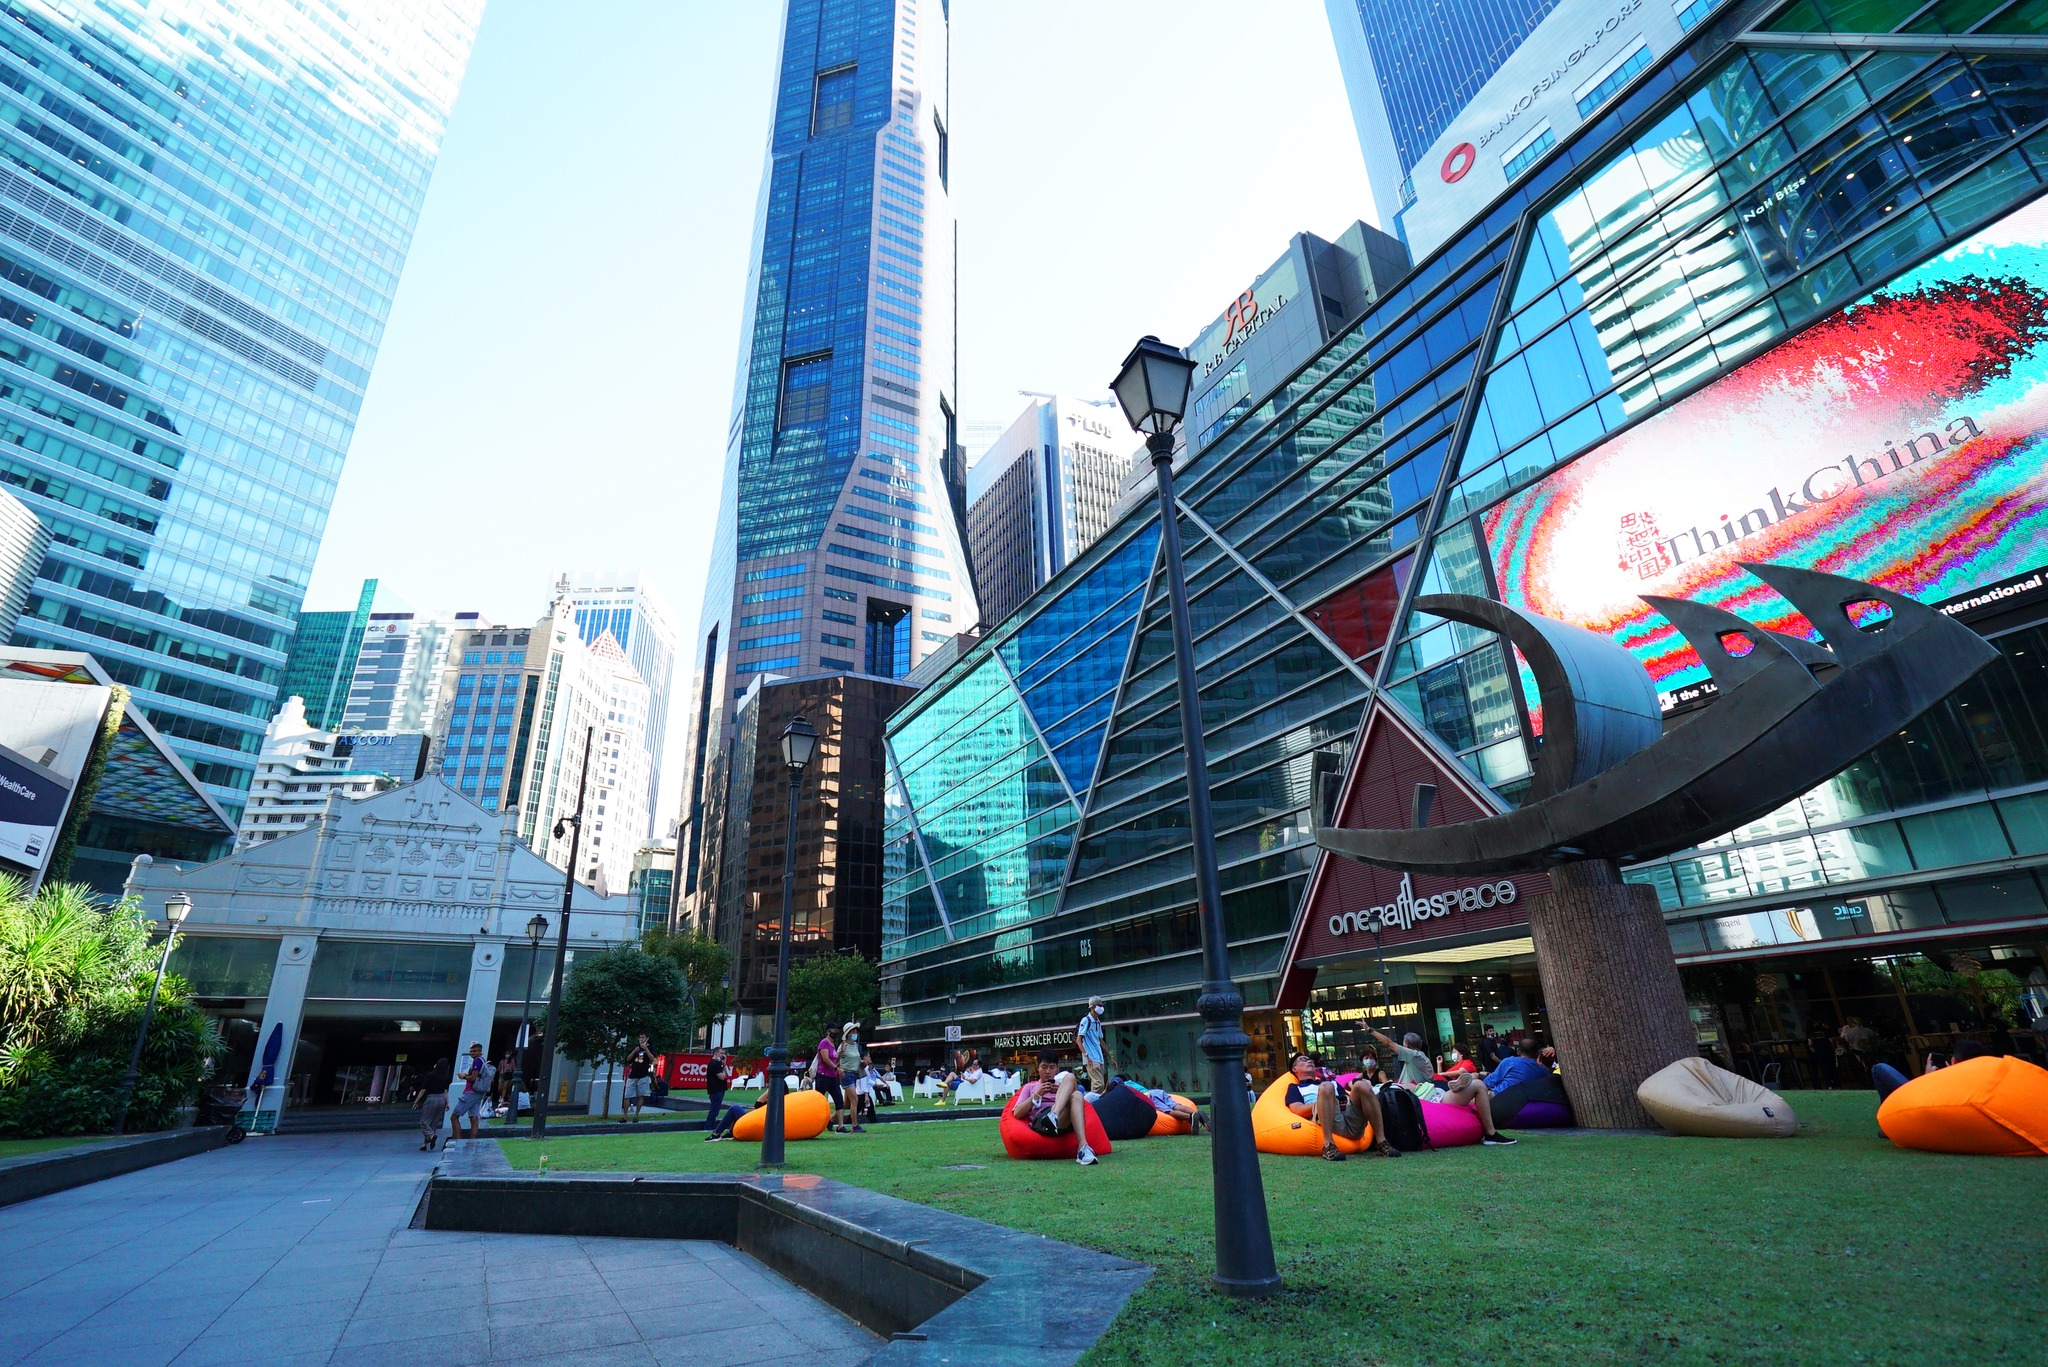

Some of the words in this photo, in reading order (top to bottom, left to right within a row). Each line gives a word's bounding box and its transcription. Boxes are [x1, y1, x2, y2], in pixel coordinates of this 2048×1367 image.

[1742, 197, 1774, 223] Nail
[1775, 176, 1807, 201] Bliss
[1202, 352, 1225, 378] RB
[1224, 294, 1288, 357] CAPITAL
[1679, 689, 1700, 702] the
[338, 735, 397, 746] ASCOTT
[1324, 1010, 1340, 1022] THE
[1340, 1008, 1371, 1021] WHISKY
[994, 1036, 1015, 1048] MARKS
[1015, 1034, 1021, 1047] &
[1021, 1033, 1052, 1046] SPENCER
[679, 1062, 734, 1077] CRON
